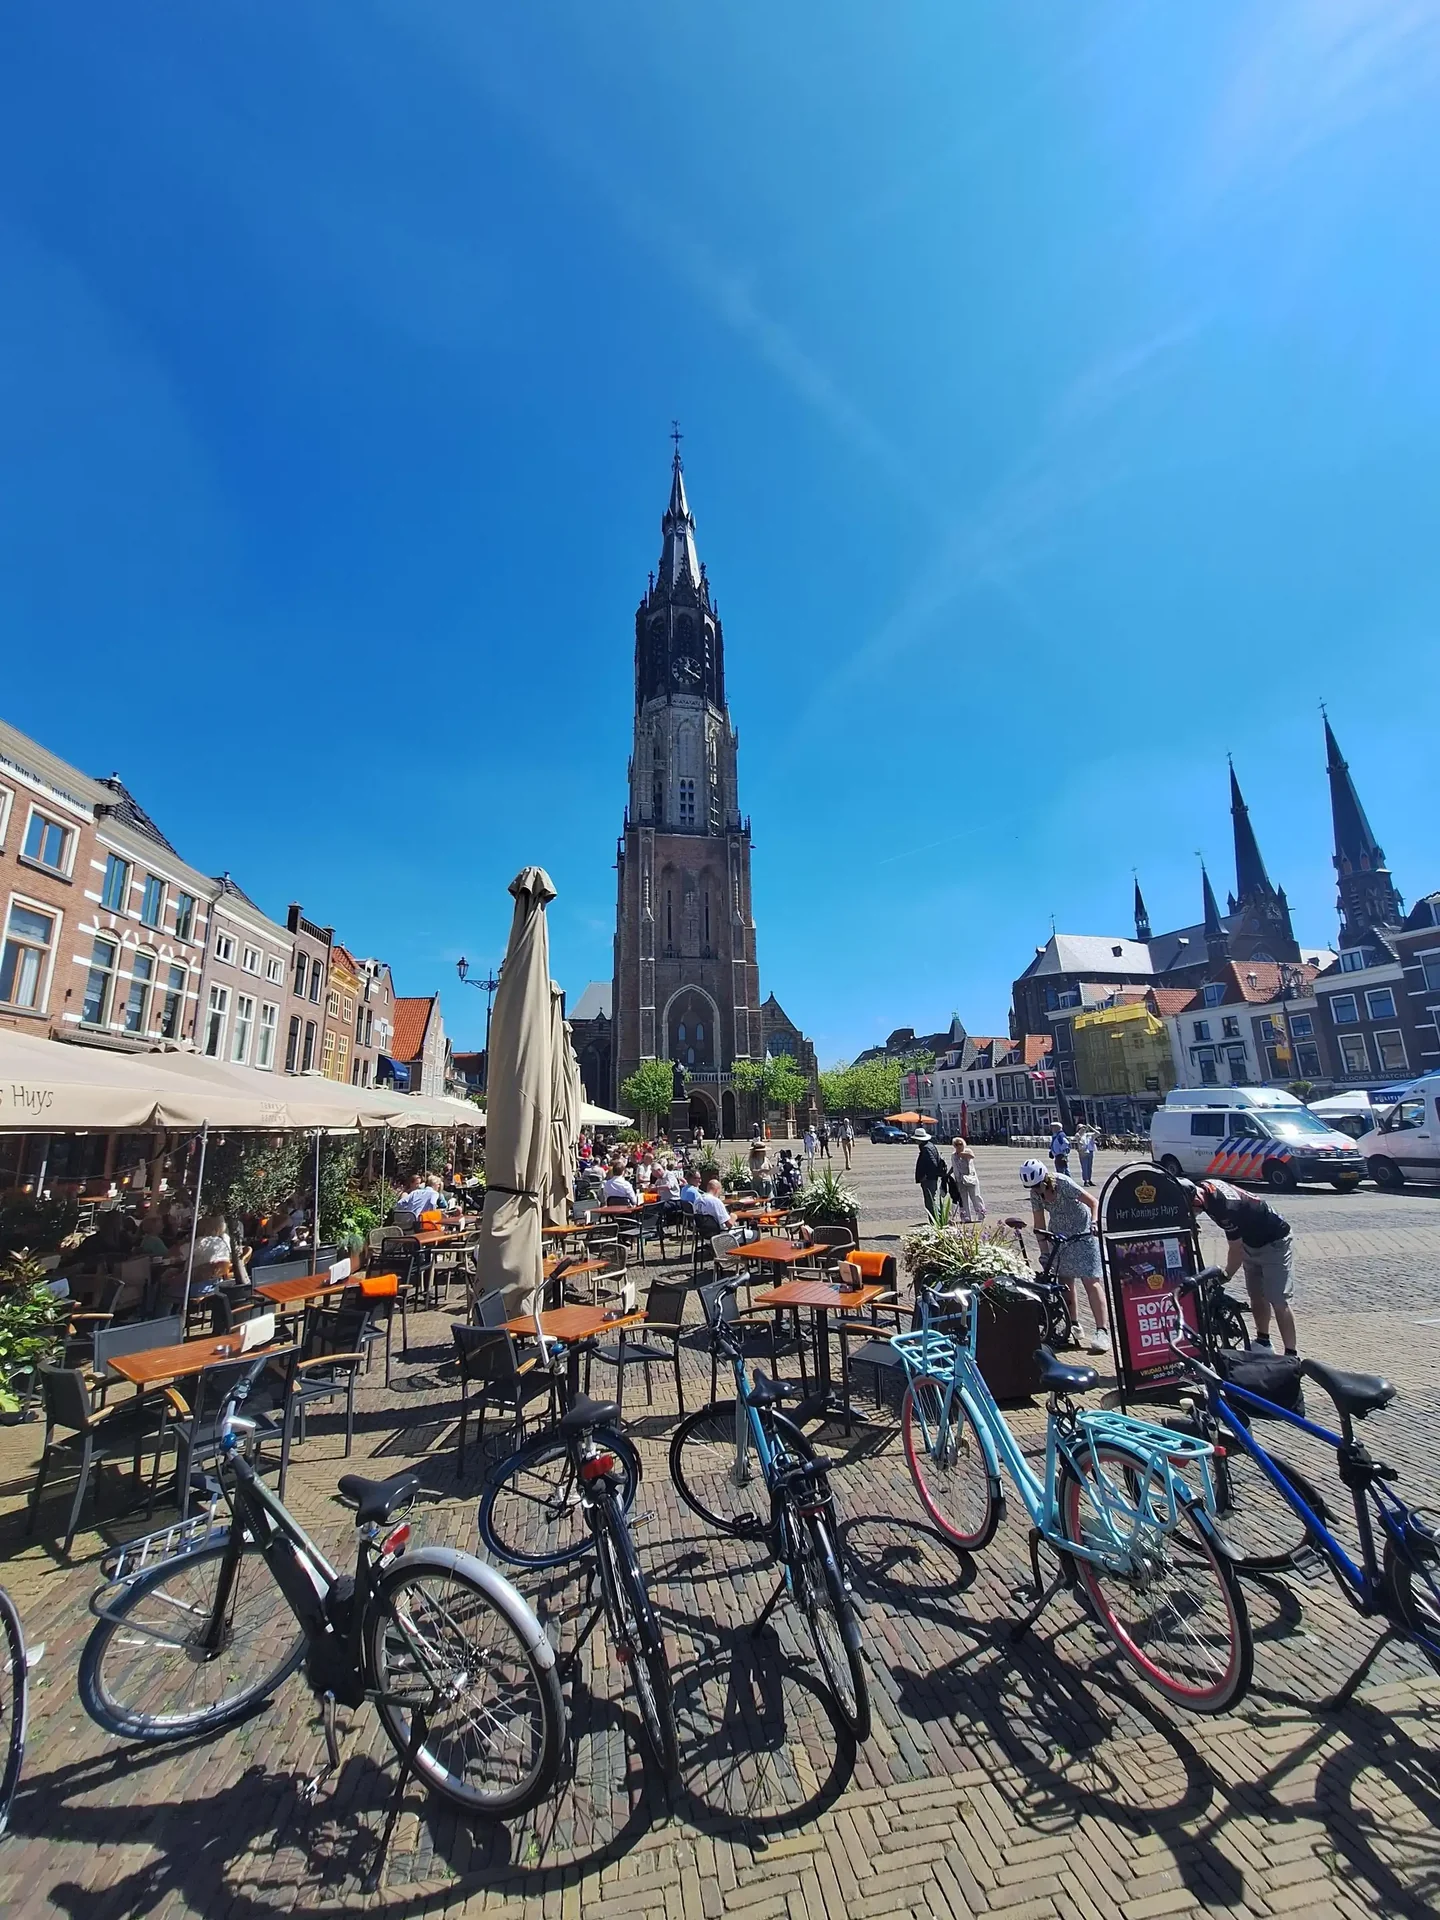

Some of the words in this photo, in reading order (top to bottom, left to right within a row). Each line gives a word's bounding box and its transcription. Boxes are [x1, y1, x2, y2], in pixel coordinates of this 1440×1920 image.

[1378, 1072, 1417, 1080] WATCHES
[11, 1085, 54, 1115] Huys
[1131, 1206, 1159, 1219] Konings
[1161, 1205, 1179, 1217] Huys
[1137, 1300, 1183, 1316] ROYA
[1139, 1314, 1180, 1332] BEAT
[1141, 1330, 1183, 1347] DELF
